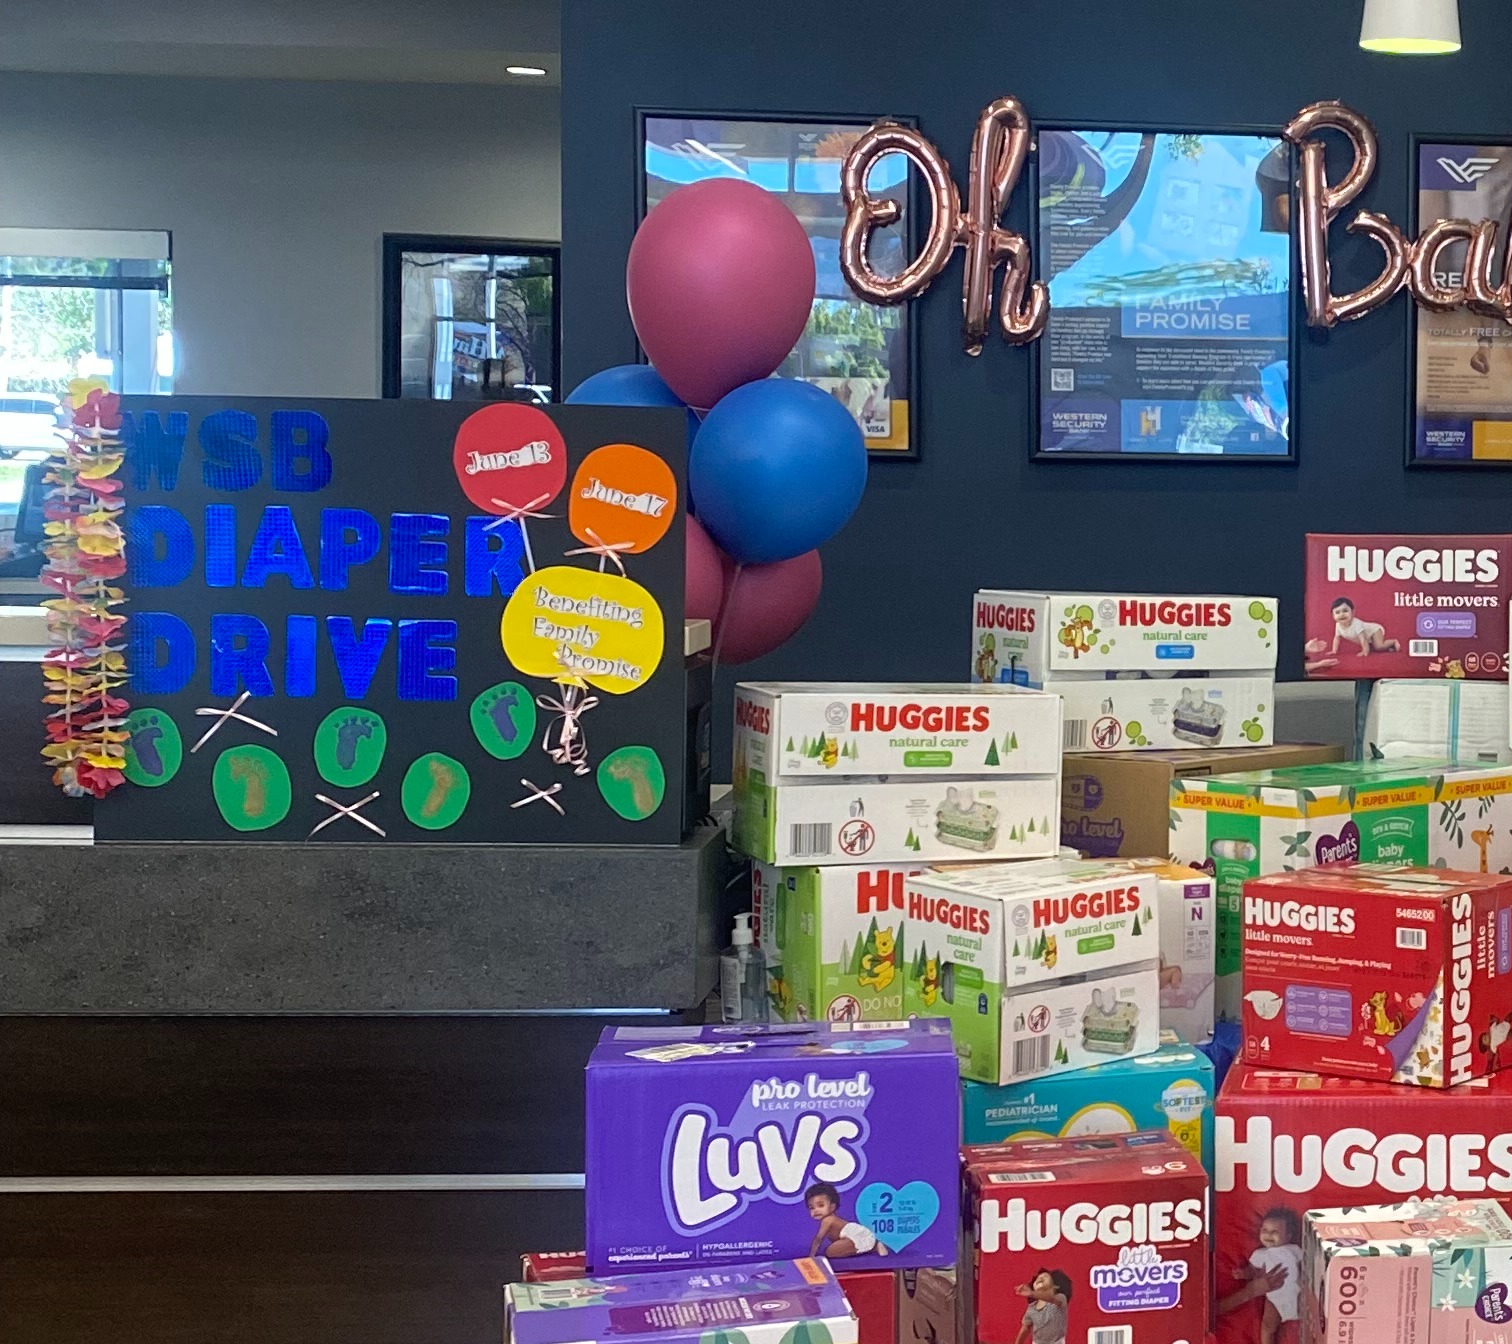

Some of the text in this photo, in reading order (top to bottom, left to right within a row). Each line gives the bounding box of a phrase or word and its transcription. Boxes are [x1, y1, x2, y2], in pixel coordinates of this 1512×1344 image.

[1136, 294, 1224, 312] FAMILY
[1136, 312, 1251, 330] PROMISE
[1469, 326, 1501, 338] FREE
[1052, 413, 1108, 422] WESTERN
[1052, 421, 1107, 429] SECURITY
[124, 409, 333, 493] WSB
[465, 441, 551, 476] June 13
[581, 477, 668, 518] June 17
[126, 504, 530, 598] DIAPER
[1327, 545, 1500, 584] HUGGIES
[532, 585, 644, 630] Benefiting
[1117, 599, 1233, 629] HUGGIES
[531, 614, 601, 653] Family
[126, 612, 460, 702] DRIVE
[851, 703, 991, 733] HUGGIES
[889, 736, 969, 748] natural care
[1183, 793, 1246, 811] SUPER VALUE
[908, 891, 990, 936] HUGGIES
[1032, 886, 1141, 929] HUGGIES
[1244, 896, 1356, 934] HUGGIES
[1476, 926, 1487, 970] little
[1486, 910, 1496, 978] movers
[1451, 893, 1473, 1086] HUGGIES
[1260, 1035, 1271, 1051] 4
[751, 1071, 871, 1108] pro level
[761, 1099, 866, 1112] LEAK PROTECTION
[1023, 1092, 1036, 1106] #1
[985, 1103, 1059, 1118] PEDIATRICIAN
[671, 1113, 860, 1227] Luvs
[878, 1191, 894, 1213] 2
[871, 1219, 895, 1234] 108
[980, 1197, 1202, 1253] HUGGIES
[1092, 1262, 1185, 1285] movers
[1338, 1265, 1359, 1316] 600
[1489, 1287, 1506, 1321] Parent's
